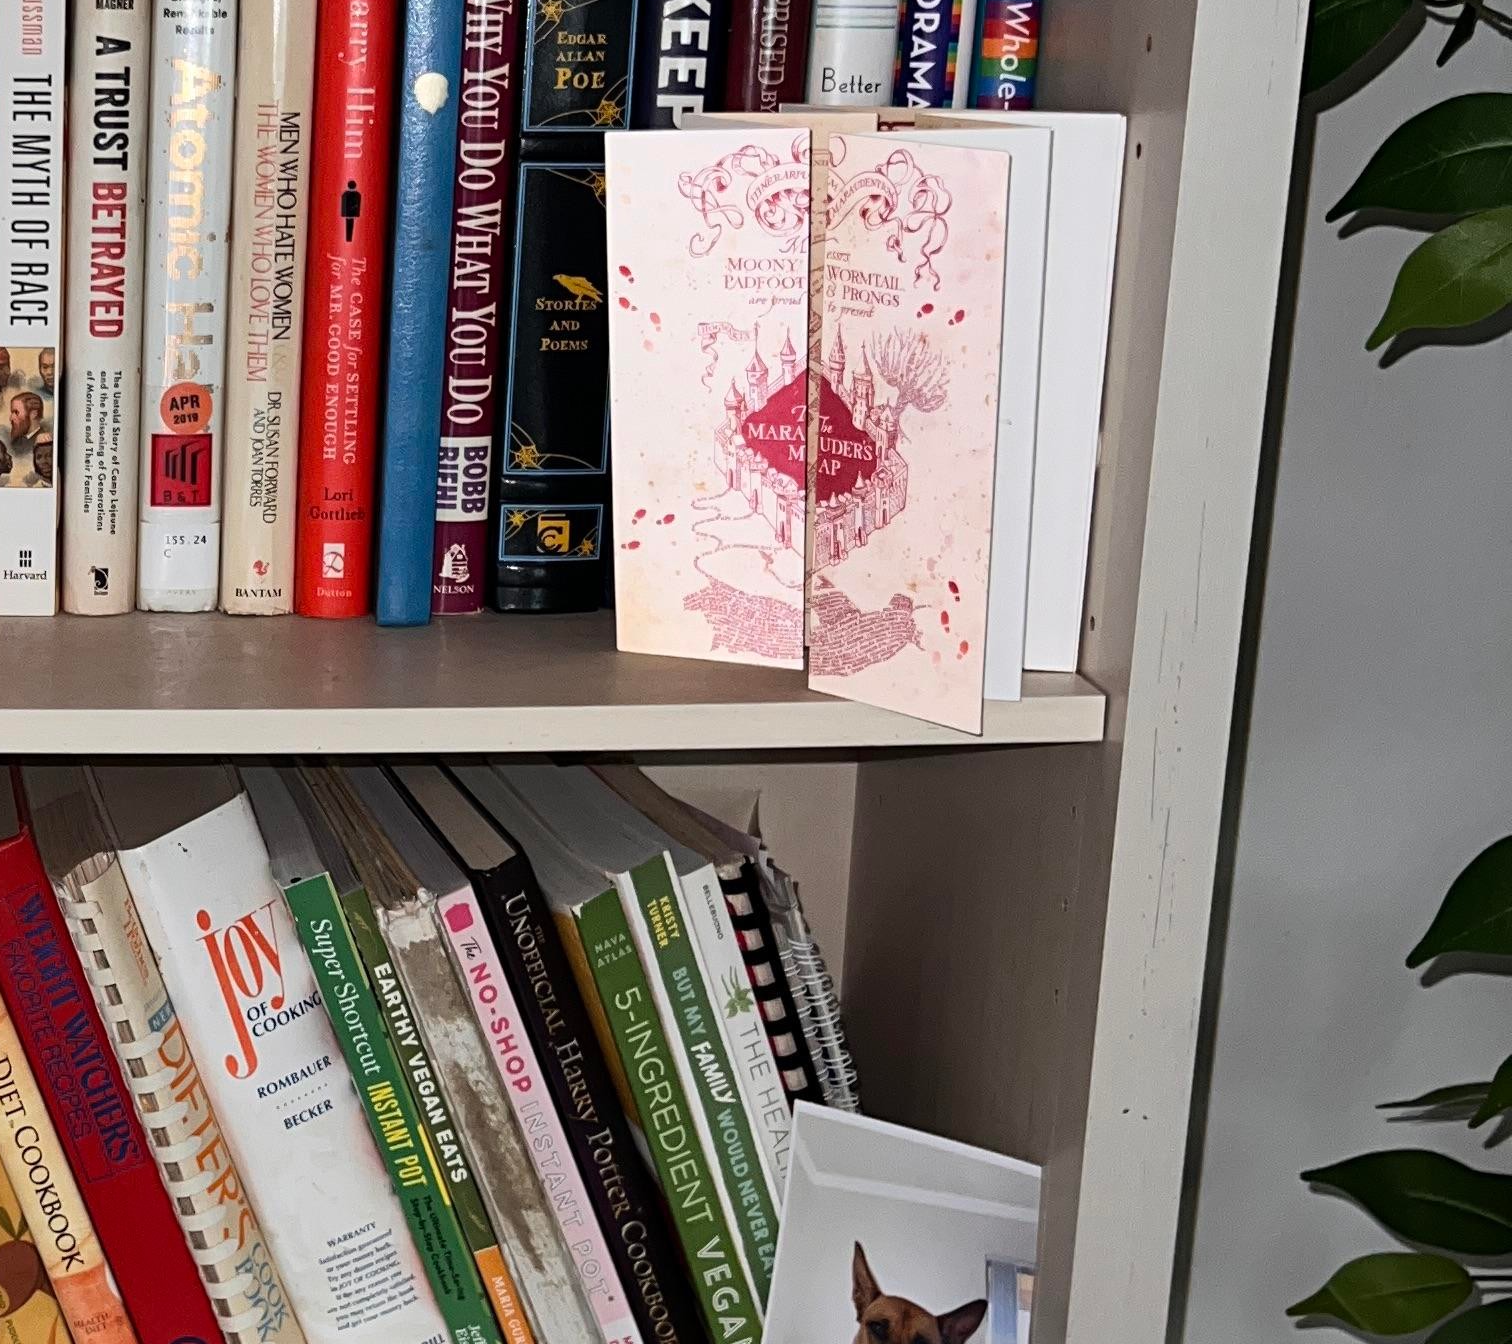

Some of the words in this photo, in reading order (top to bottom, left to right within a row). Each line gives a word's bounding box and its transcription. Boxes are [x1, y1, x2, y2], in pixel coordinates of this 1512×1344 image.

[94, 35, 132, 57] A
[557, 31, 607, 47] EDGAR
[557, 49, 605, 63] ALLAN
[461, 61, 509, 131] YOU
[556, 67, 605, 90] POE
[821, 68, 881, 95] Better
[9, 74, 51, 128] THE
[91, 66, 131, 171] TRUST
[9, 134, 51, 212] MYTH
[457, 139, 506, 191] DO
[9, 220, 51, 249] OF
[453, 200, 503, 294] WHAT
[88, 181, 128, 339] BETRAYED
[726, 256, 797, 273] MOONY
[826, 264, 902, 291] WORMTAIL
[8, 255, 50, 328] RACE
[723, 274, 807, 290] PADFOOT
[535, 297, 597, 312] STORIES
[450, 297, 497, 367] YOU
[540, 337, 588, 352] POEMS
[550, 319, 580, 332] AND
[168, 394, 201, 412] APR
[445, 372, 493, 425] DO
[173, 413, 199, 425] 2019
[461, 445, 489, 514] BOBB
[3, 568, 47, 581] Harvard
[235, 586, 282, 599] BANTAM
[195, 901, 280, 1079] joy
[308, 917, 344, 979] Super
[335, 981, 382, 1076] Shortcut
[246, 1001, 270, 1022] OF
[251, 991, 322, 1039] COOKING
[469, 962, 533, 1094] NO-SHOP
[256, 1054, 333, 1099] ROMBAUER
[374, 962, 420, 1047] EARTHY
[408, 1051, 450, 1123] VEGAN
[433, 1127, 470, 1185] EATS
[282, 1098, 334, 1131] BECKER
[368, 1080, 415, 1155] INSTANT
[392, 1151, 428, 1187] POT
